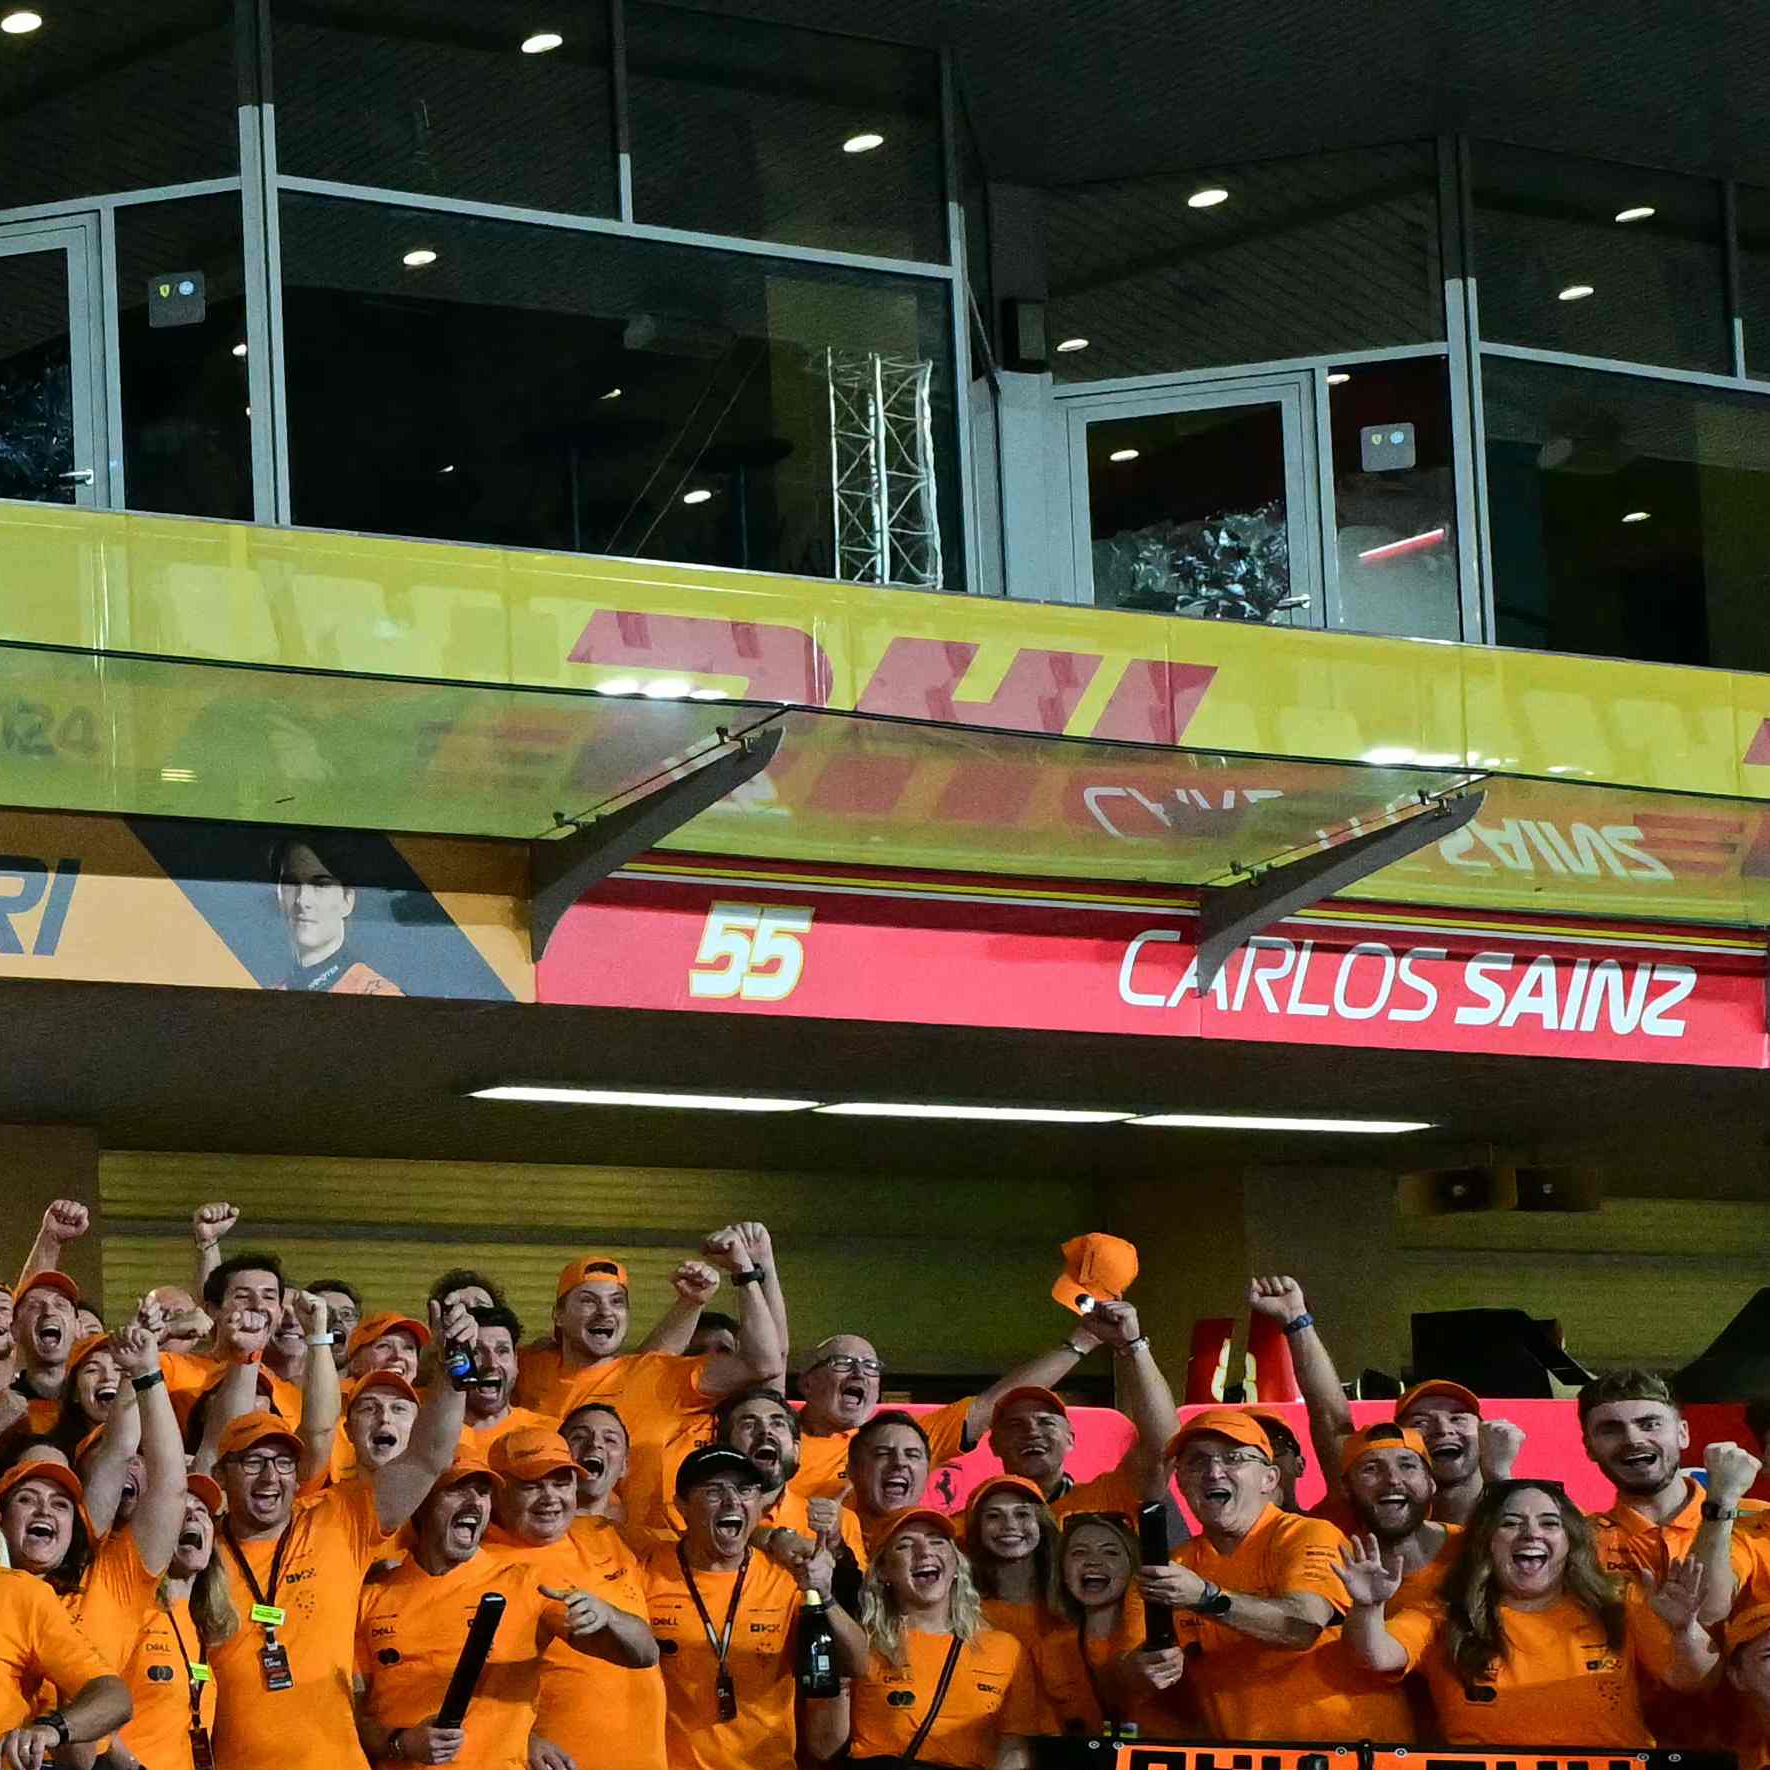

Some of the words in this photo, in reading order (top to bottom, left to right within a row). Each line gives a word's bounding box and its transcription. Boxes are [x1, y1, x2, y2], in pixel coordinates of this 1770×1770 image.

[567, 607, 1219, 747] DHL
[689, 900, 816, 1002] 55
[1117, 928, 1449, 1023] CARLOS
[1454, 952, 1696, 1038] SAINZ
